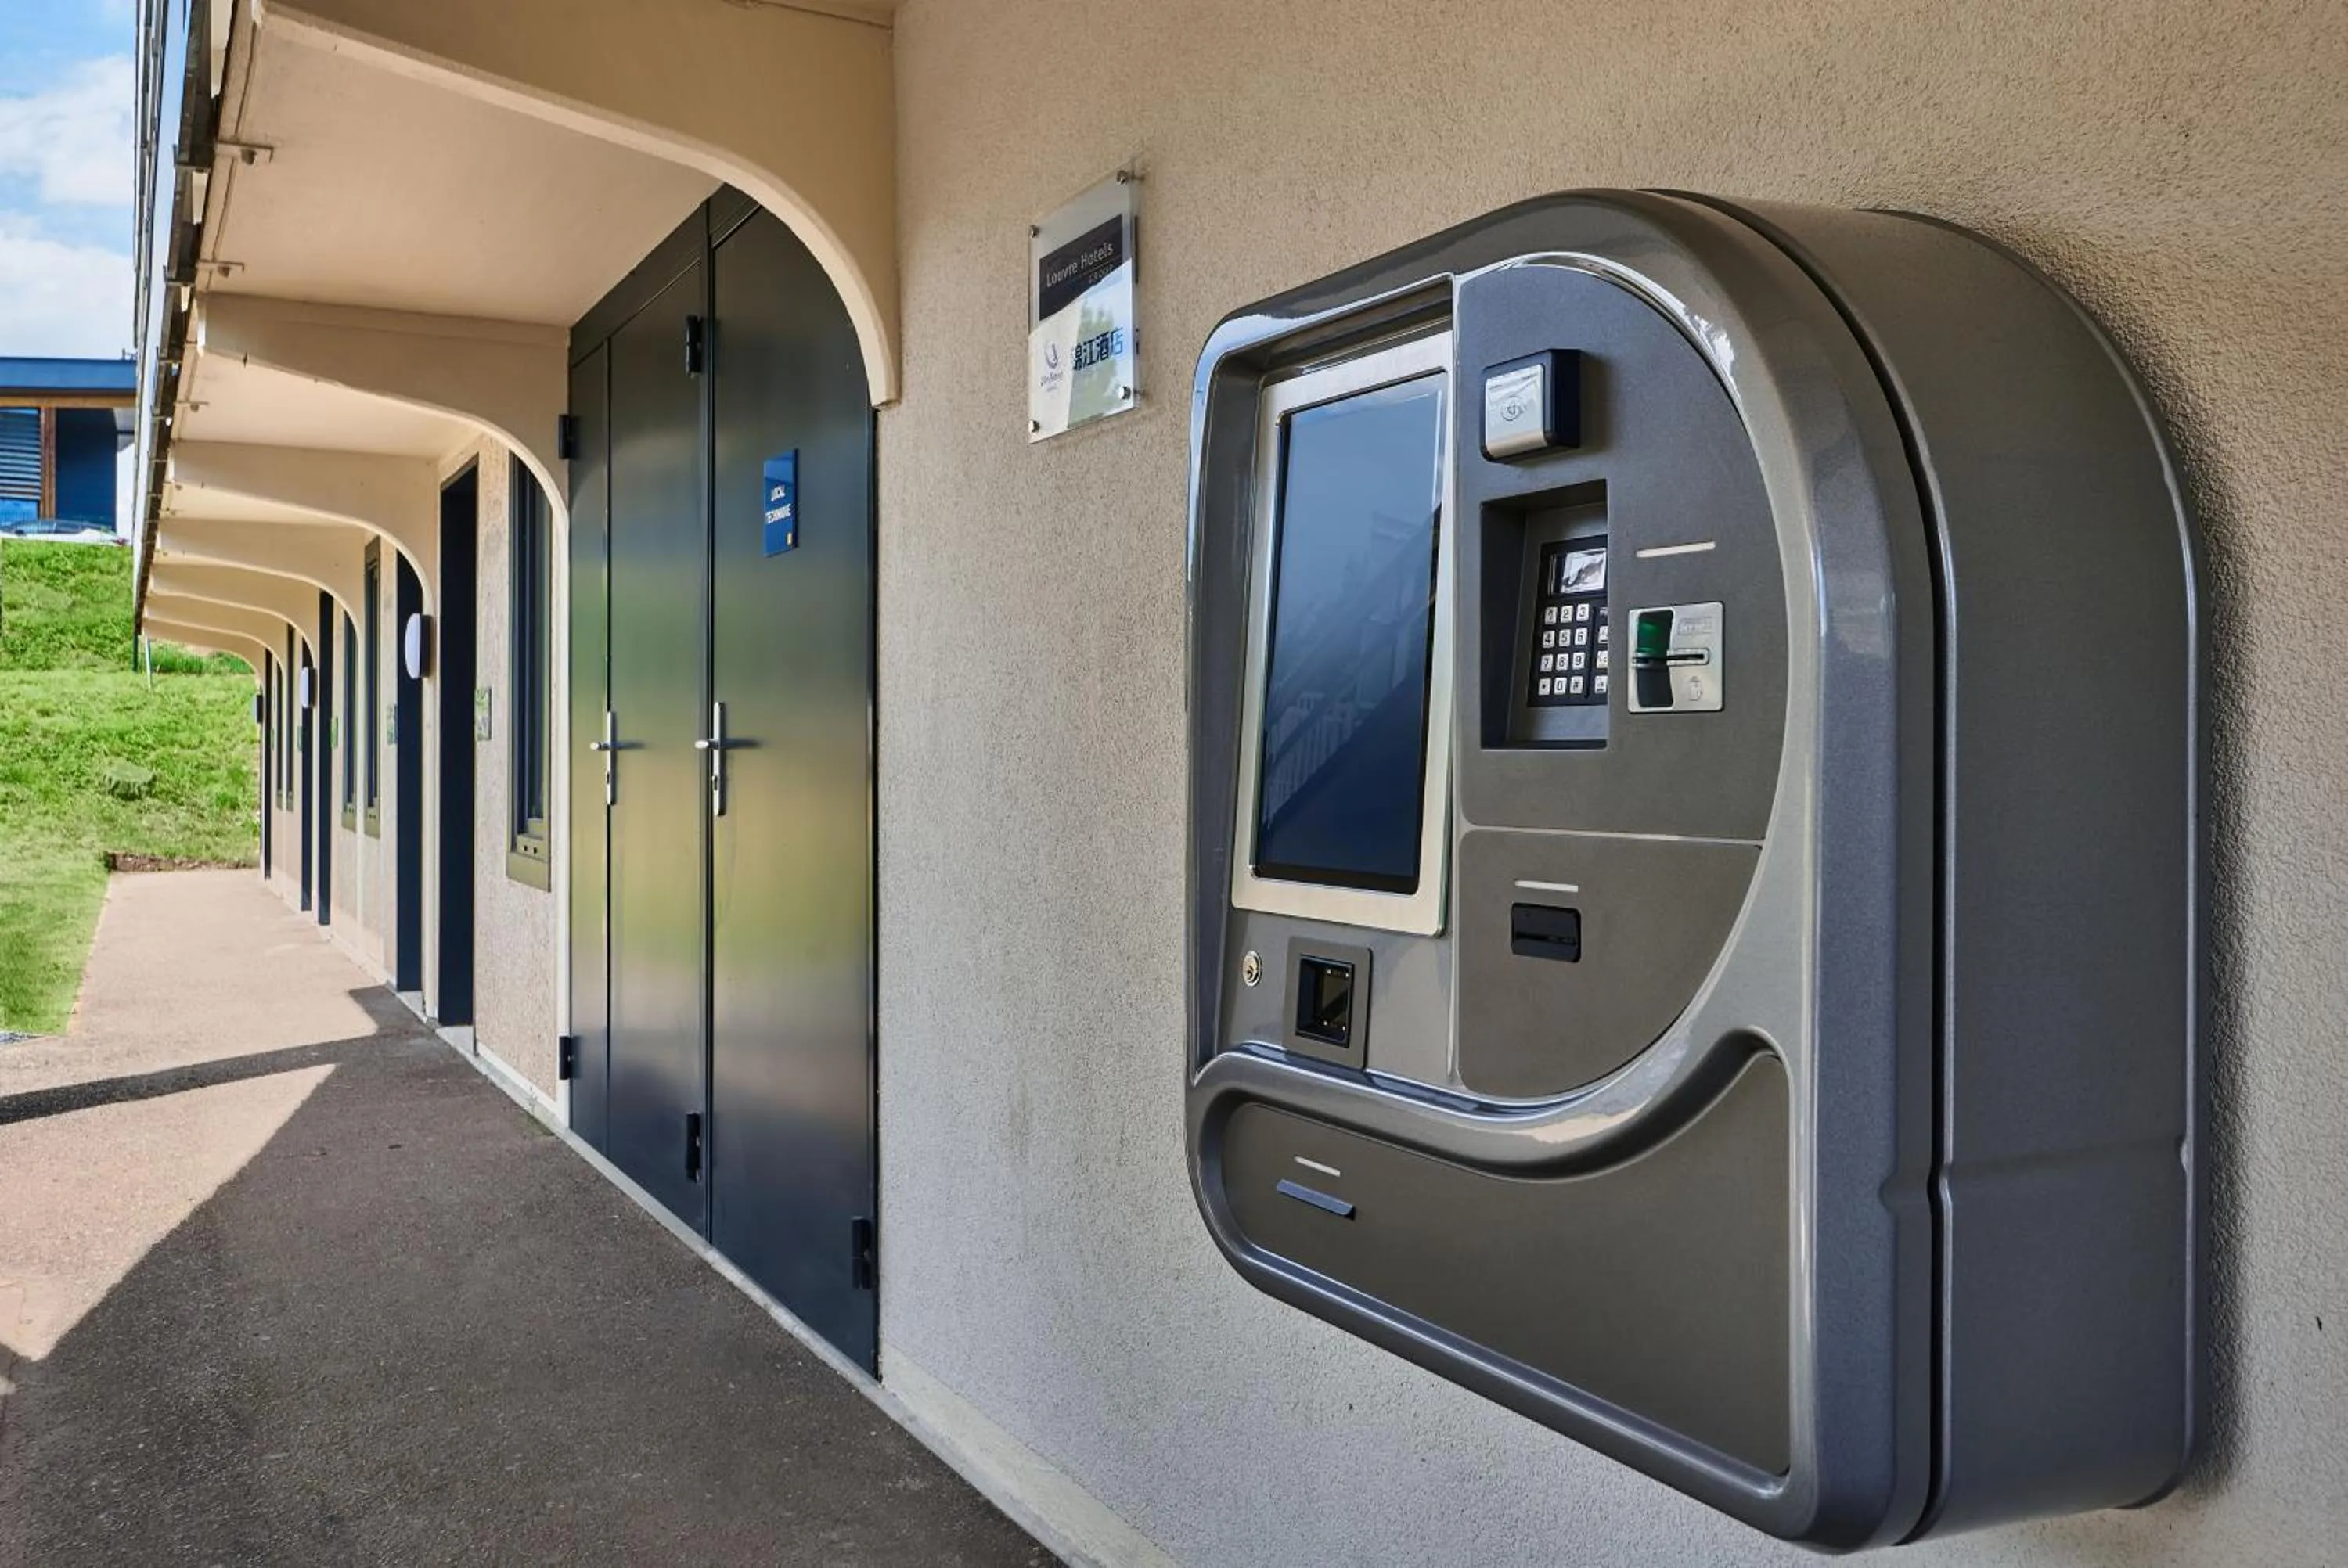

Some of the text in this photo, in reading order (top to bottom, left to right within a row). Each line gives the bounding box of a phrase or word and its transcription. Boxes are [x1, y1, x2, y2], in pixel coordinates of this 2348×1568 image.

[1046, 242, 1114, 288] Louvre Hotels
[1563, 608, 1569, 619] 2
[1579, 606, 1586, 617] 3
[1544, 631, 1583, 644] 4 5 6
[1575, 655, 1582, 666] 9
[1556, 680, 1563, 691] 0
